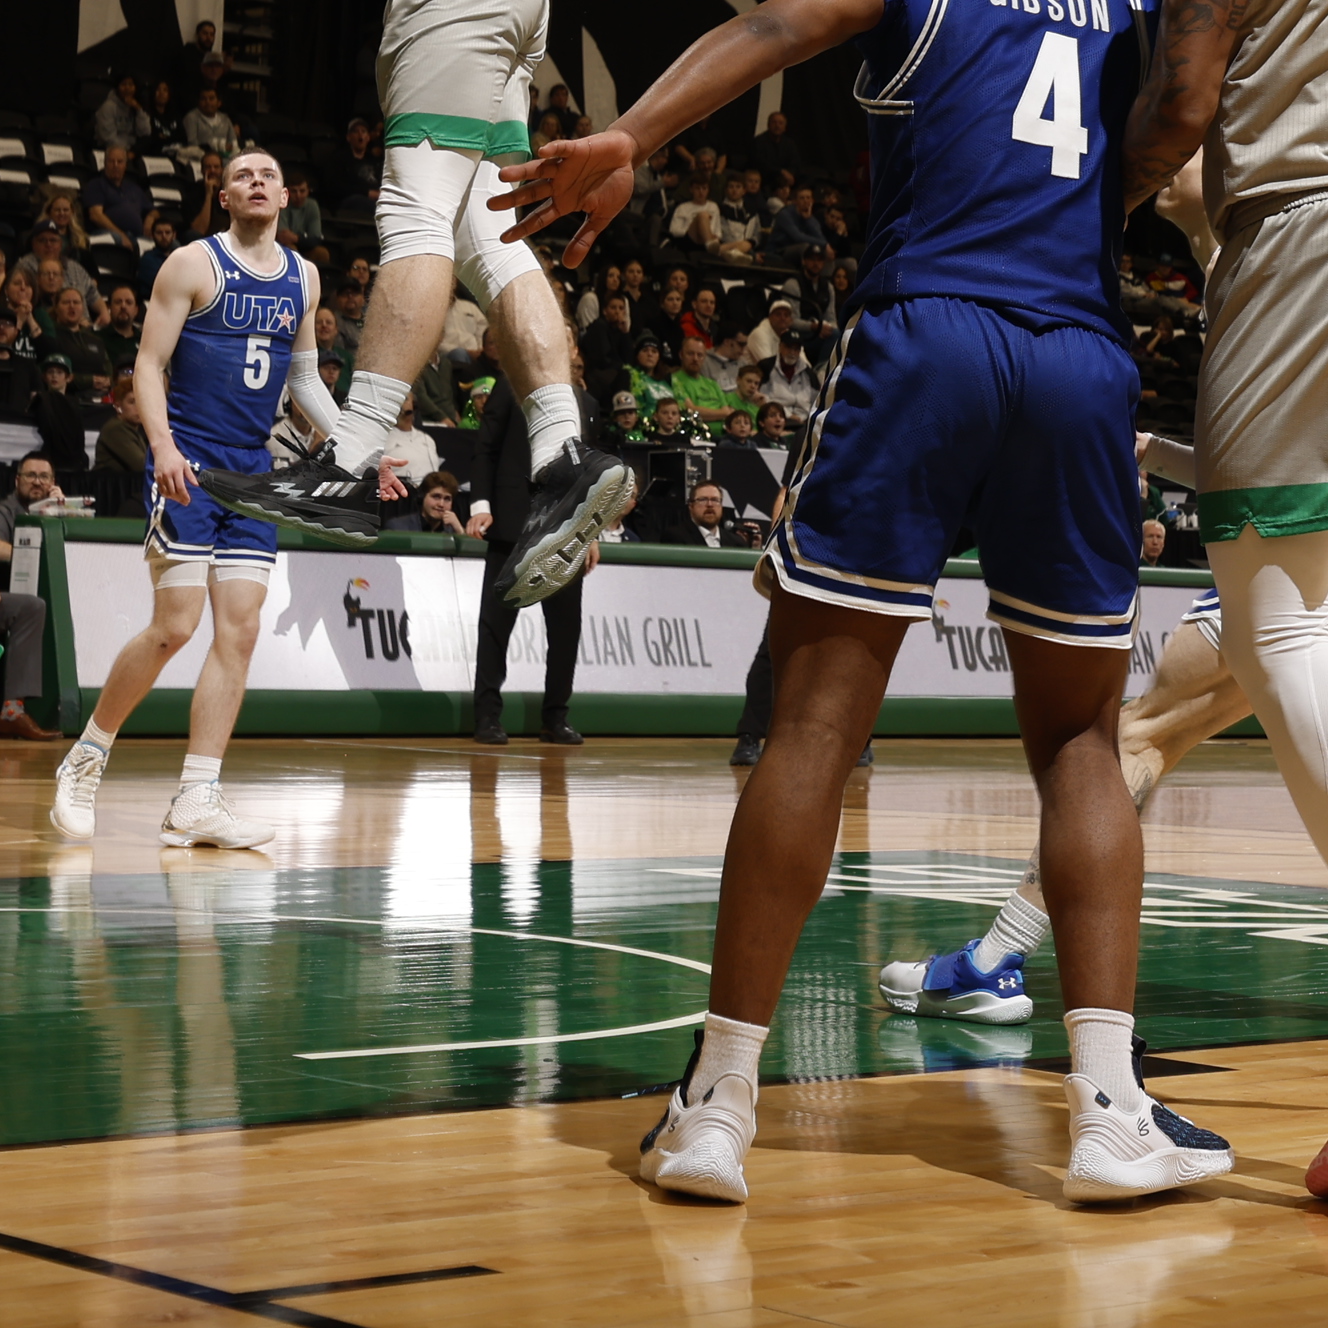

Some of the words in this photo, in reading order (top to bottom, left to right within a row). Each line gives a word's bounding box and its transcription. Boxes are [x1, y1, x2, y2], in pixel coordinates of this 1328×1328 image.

[1012, 30, 1088, 180] 4
[222, 292, 297, 334] UTA
[243, 333, 272, 390] 5
[643, 617, 713, 668] GRILL
